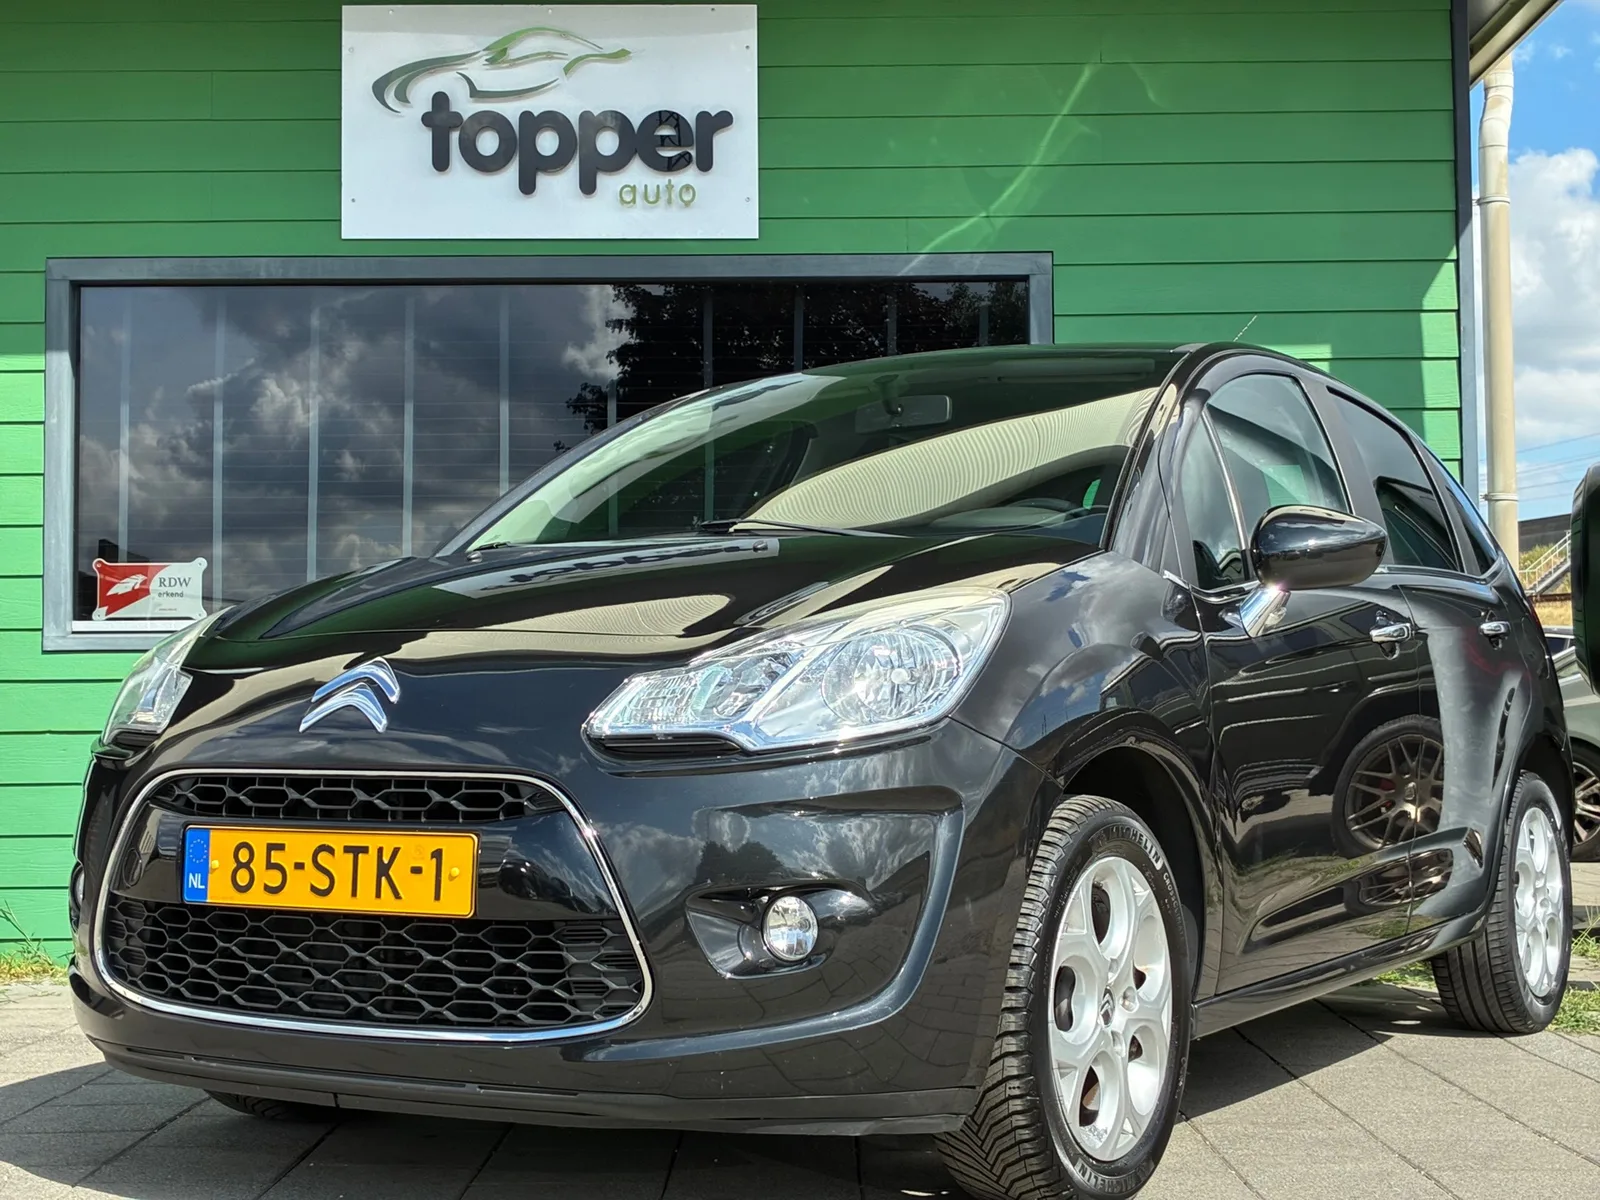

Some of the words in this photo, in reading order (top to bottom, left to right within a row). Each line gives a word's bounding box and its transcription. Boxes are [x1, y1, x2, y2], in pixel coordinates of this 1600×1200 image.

[421, 91, 734, 195] topper
[619, 178, 697, 207] auto
[158, 577, 192, 588] RDW
[157, 590, 184, 598] erkend
[188, 873, 205, 889] NL
[230, 841, 444, 902] 85-STK-1
